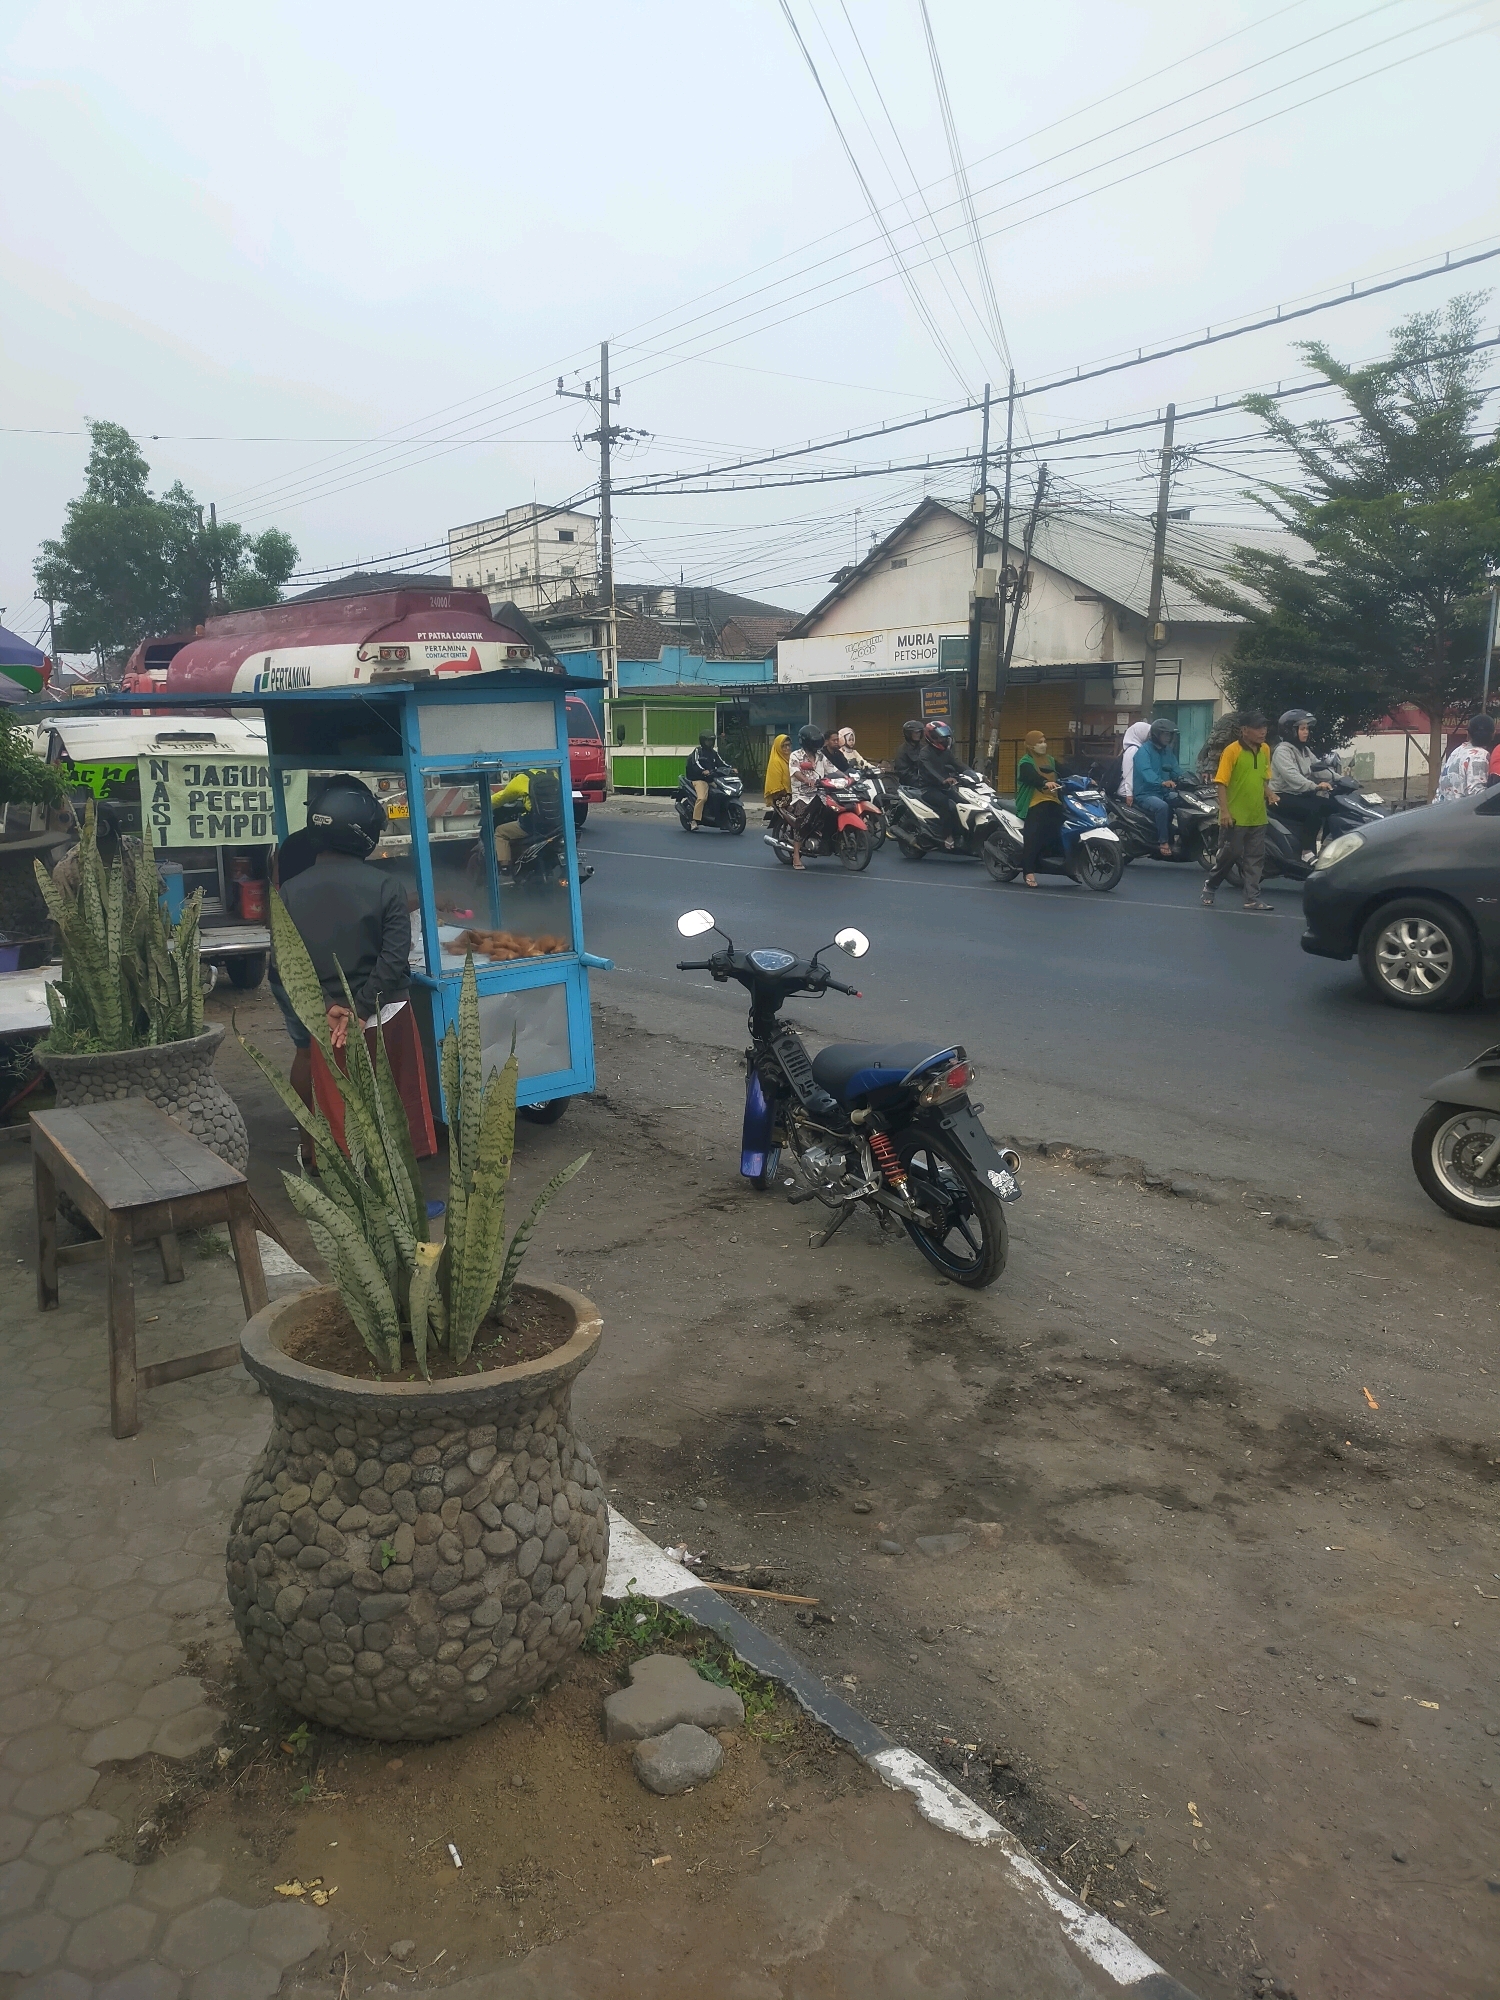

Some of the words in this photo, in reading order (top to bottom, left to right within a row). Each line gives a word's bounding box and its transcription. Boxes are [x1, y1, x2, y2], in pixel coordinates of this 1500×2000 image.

[897, 633, 934, 647] MURIA
[894, 648, 938, 661] PETSHOP
[270, 666, 311, 691] PERTAMINA
[149, 759, 171, 846] NASI
[188, 790, 274, 812] PECEL
